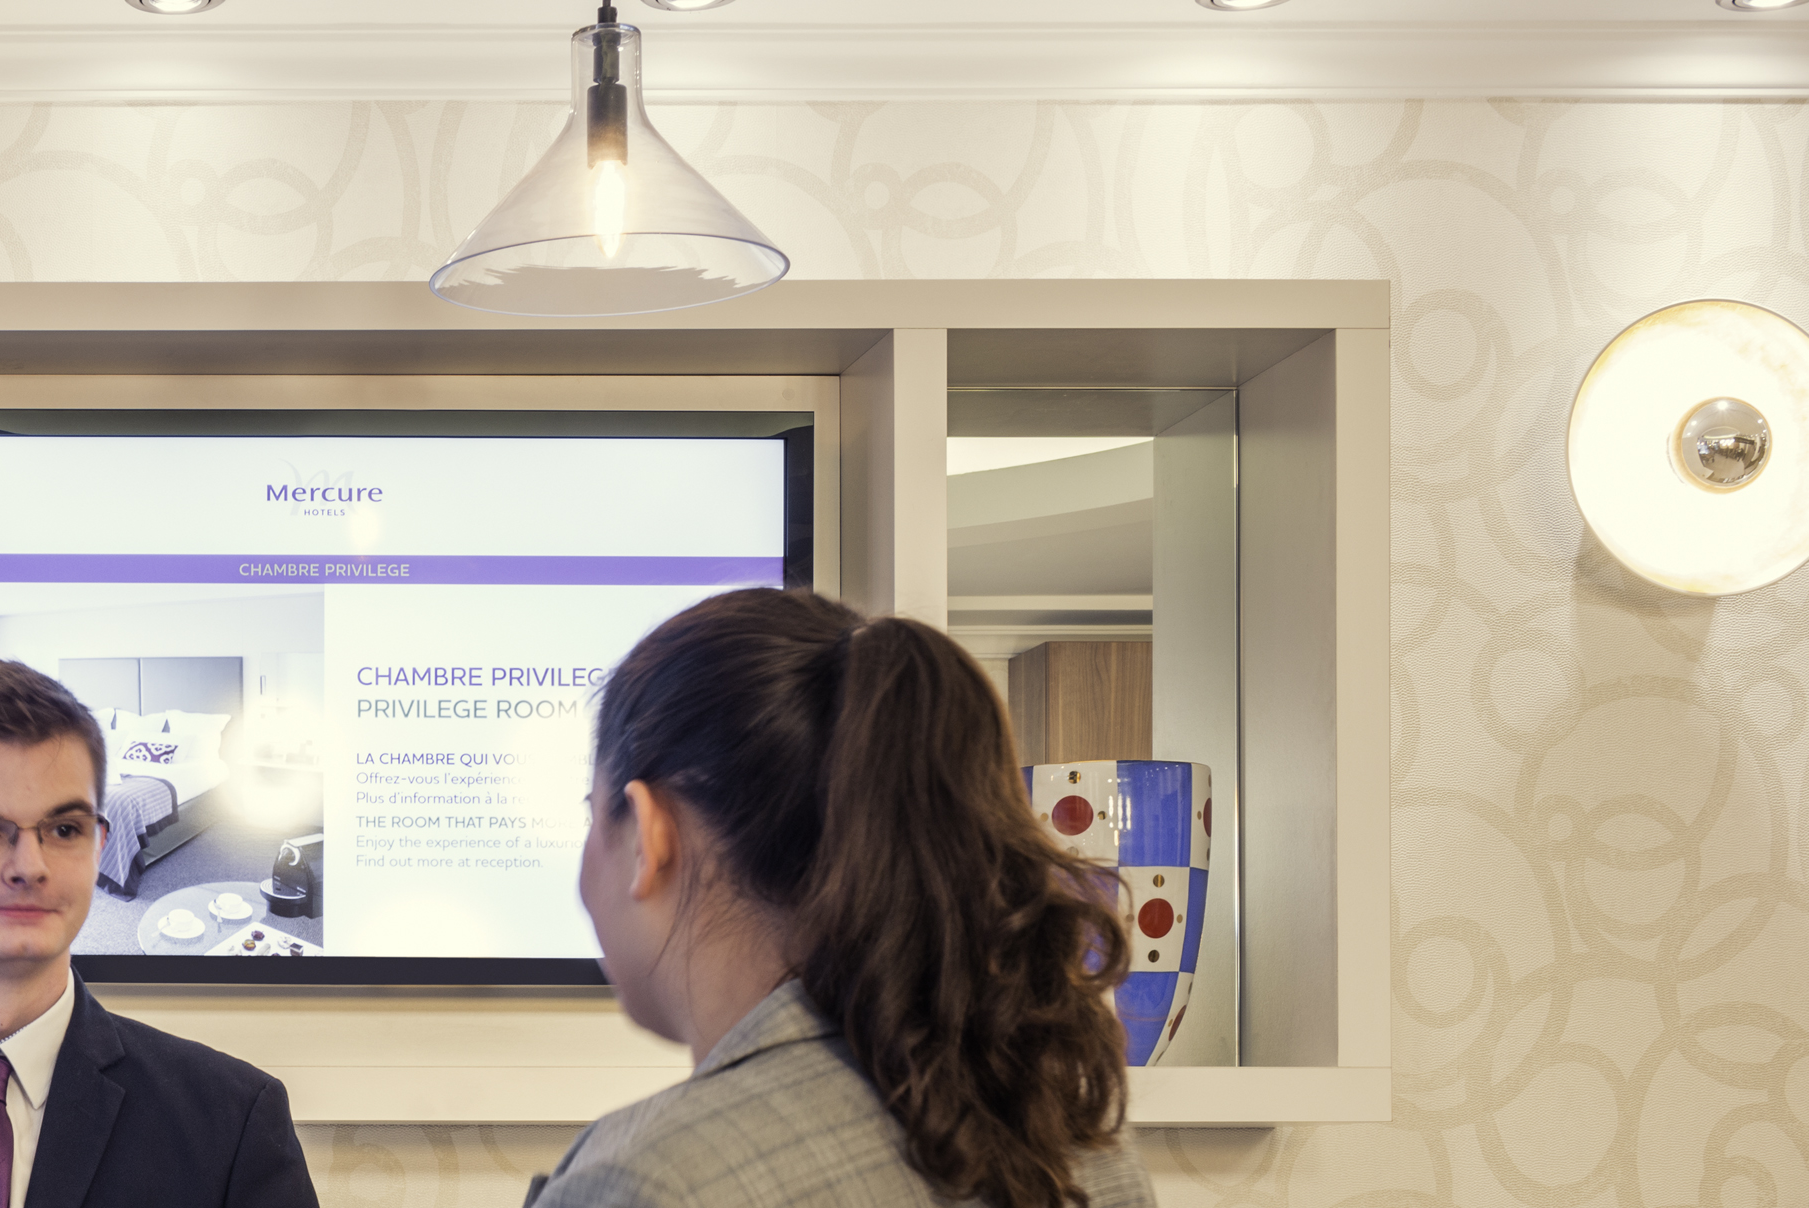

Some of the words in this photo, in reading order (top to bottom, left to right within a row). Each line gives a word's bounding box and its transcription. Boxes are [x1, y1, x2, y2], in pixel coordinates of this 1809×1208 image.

[267, 485, 383, 502] Mercure
[239, 563, 319, 576] CHAMBRE
[325, 564, 409, 576] PRIVILEGE
[357, 667, 482, 686] CHAMBRE
[492, 667, 608, 687] PRIVILEG
[358, 699, 487, 718] PRIVILEGE
[497, 700, 577, 718] ROOM
[357, 753, 374, 764] LA
[379, 753, 454, 765] CHAMBRE
[460, 753, 488, 767] QUI
[357, 772, 439, 784] Offrez-vous
[357, 792, 384, 803] Plus
[389, 792, 480, 804] d'information
[497, 793, 507, 804] la
[357, 816, 386, 828] THE
[392, 816, 440, 828] ROOM
[445, 816, 484, 828] THAT
[489, 816, 526, 828] PAYS
[356, 835, 394, 852] Enjoy
[399, 836, 421, 848] the
[426, 839, 501, 852] experience
[506, 836, 521, 848] of
[524, 839, 532, 848] a
[536, 836, 584, 848] luxurio
[356, 855, 384, 867] Find
[389, 858, 412, 867] out
[418, 859, 453, 867] more
[458, 858, 470, 867] at
[476, 858, 543, 871] reception.
